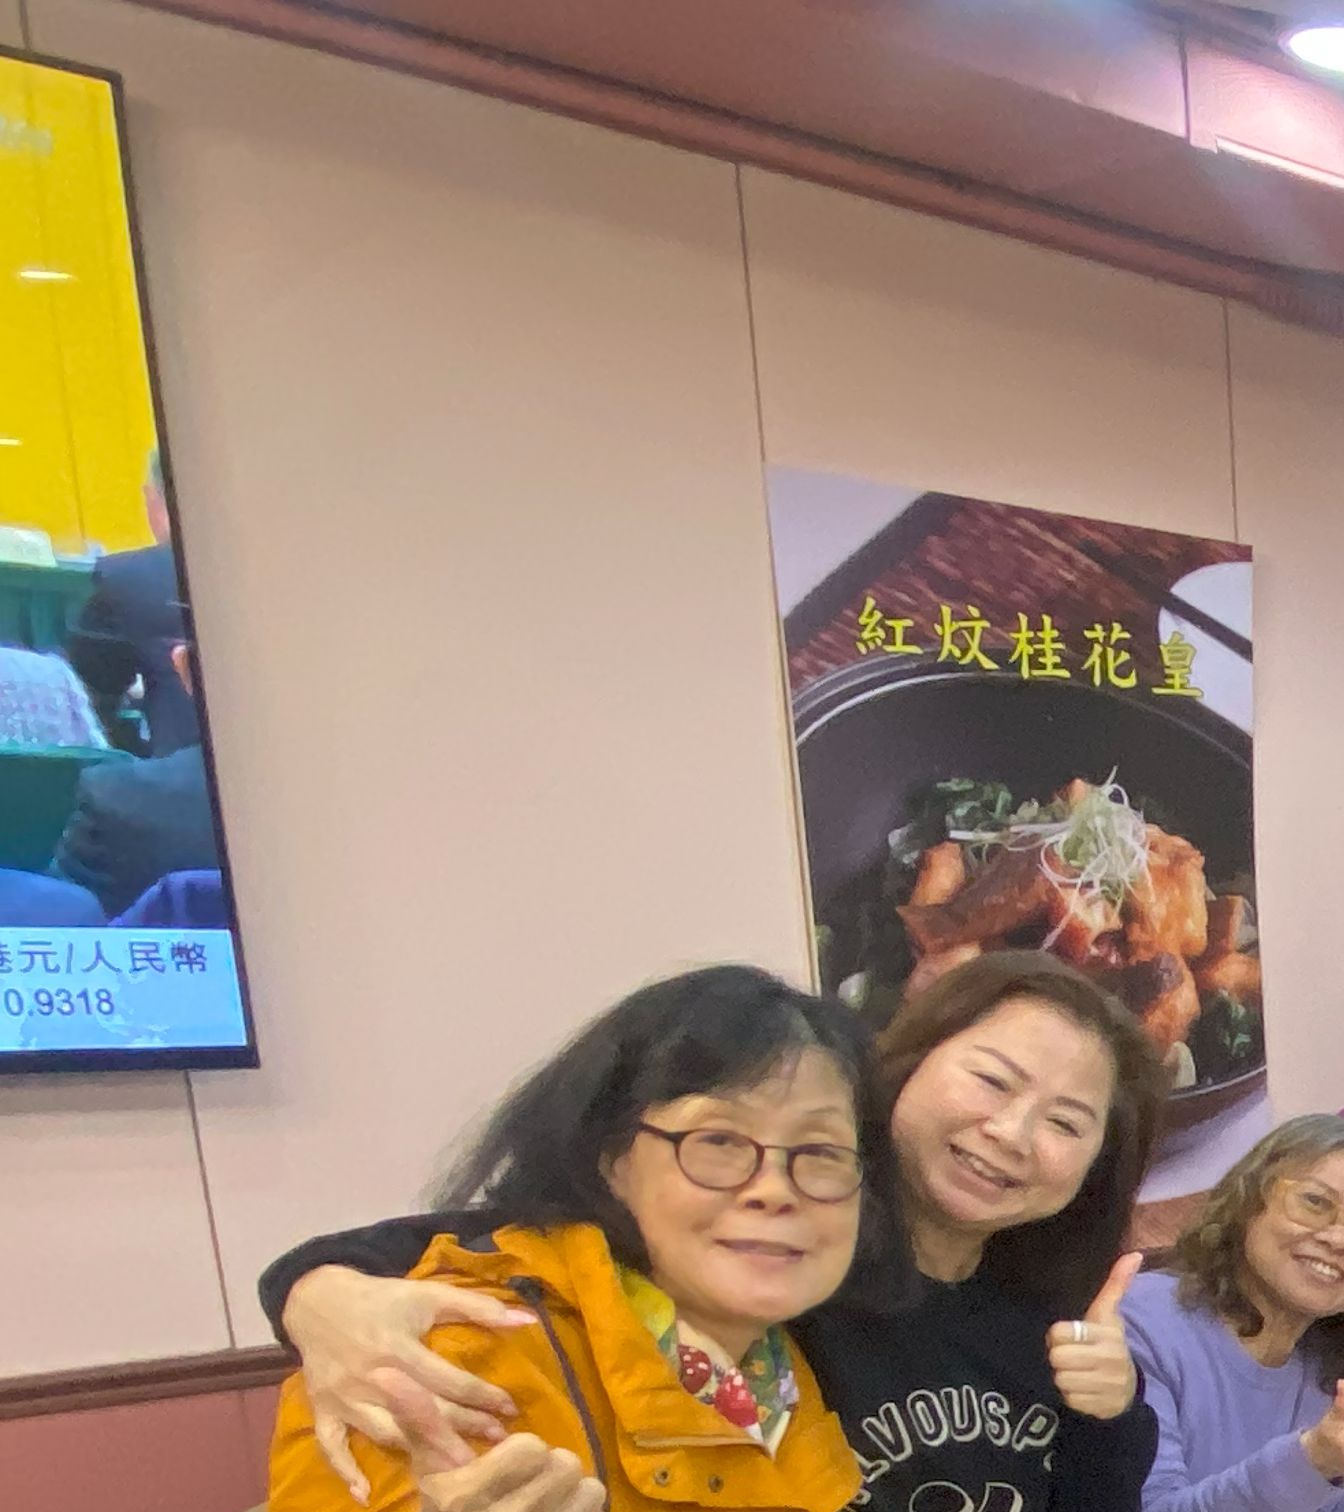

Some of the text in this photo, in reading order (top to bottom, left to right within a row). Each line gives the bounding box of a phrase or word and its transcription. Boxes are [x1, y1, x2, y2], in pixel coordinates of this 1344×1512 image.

[856, 596, 1204, 701] 紅炆桂花皇
[4, 988, 115, 1017] 0.9318
